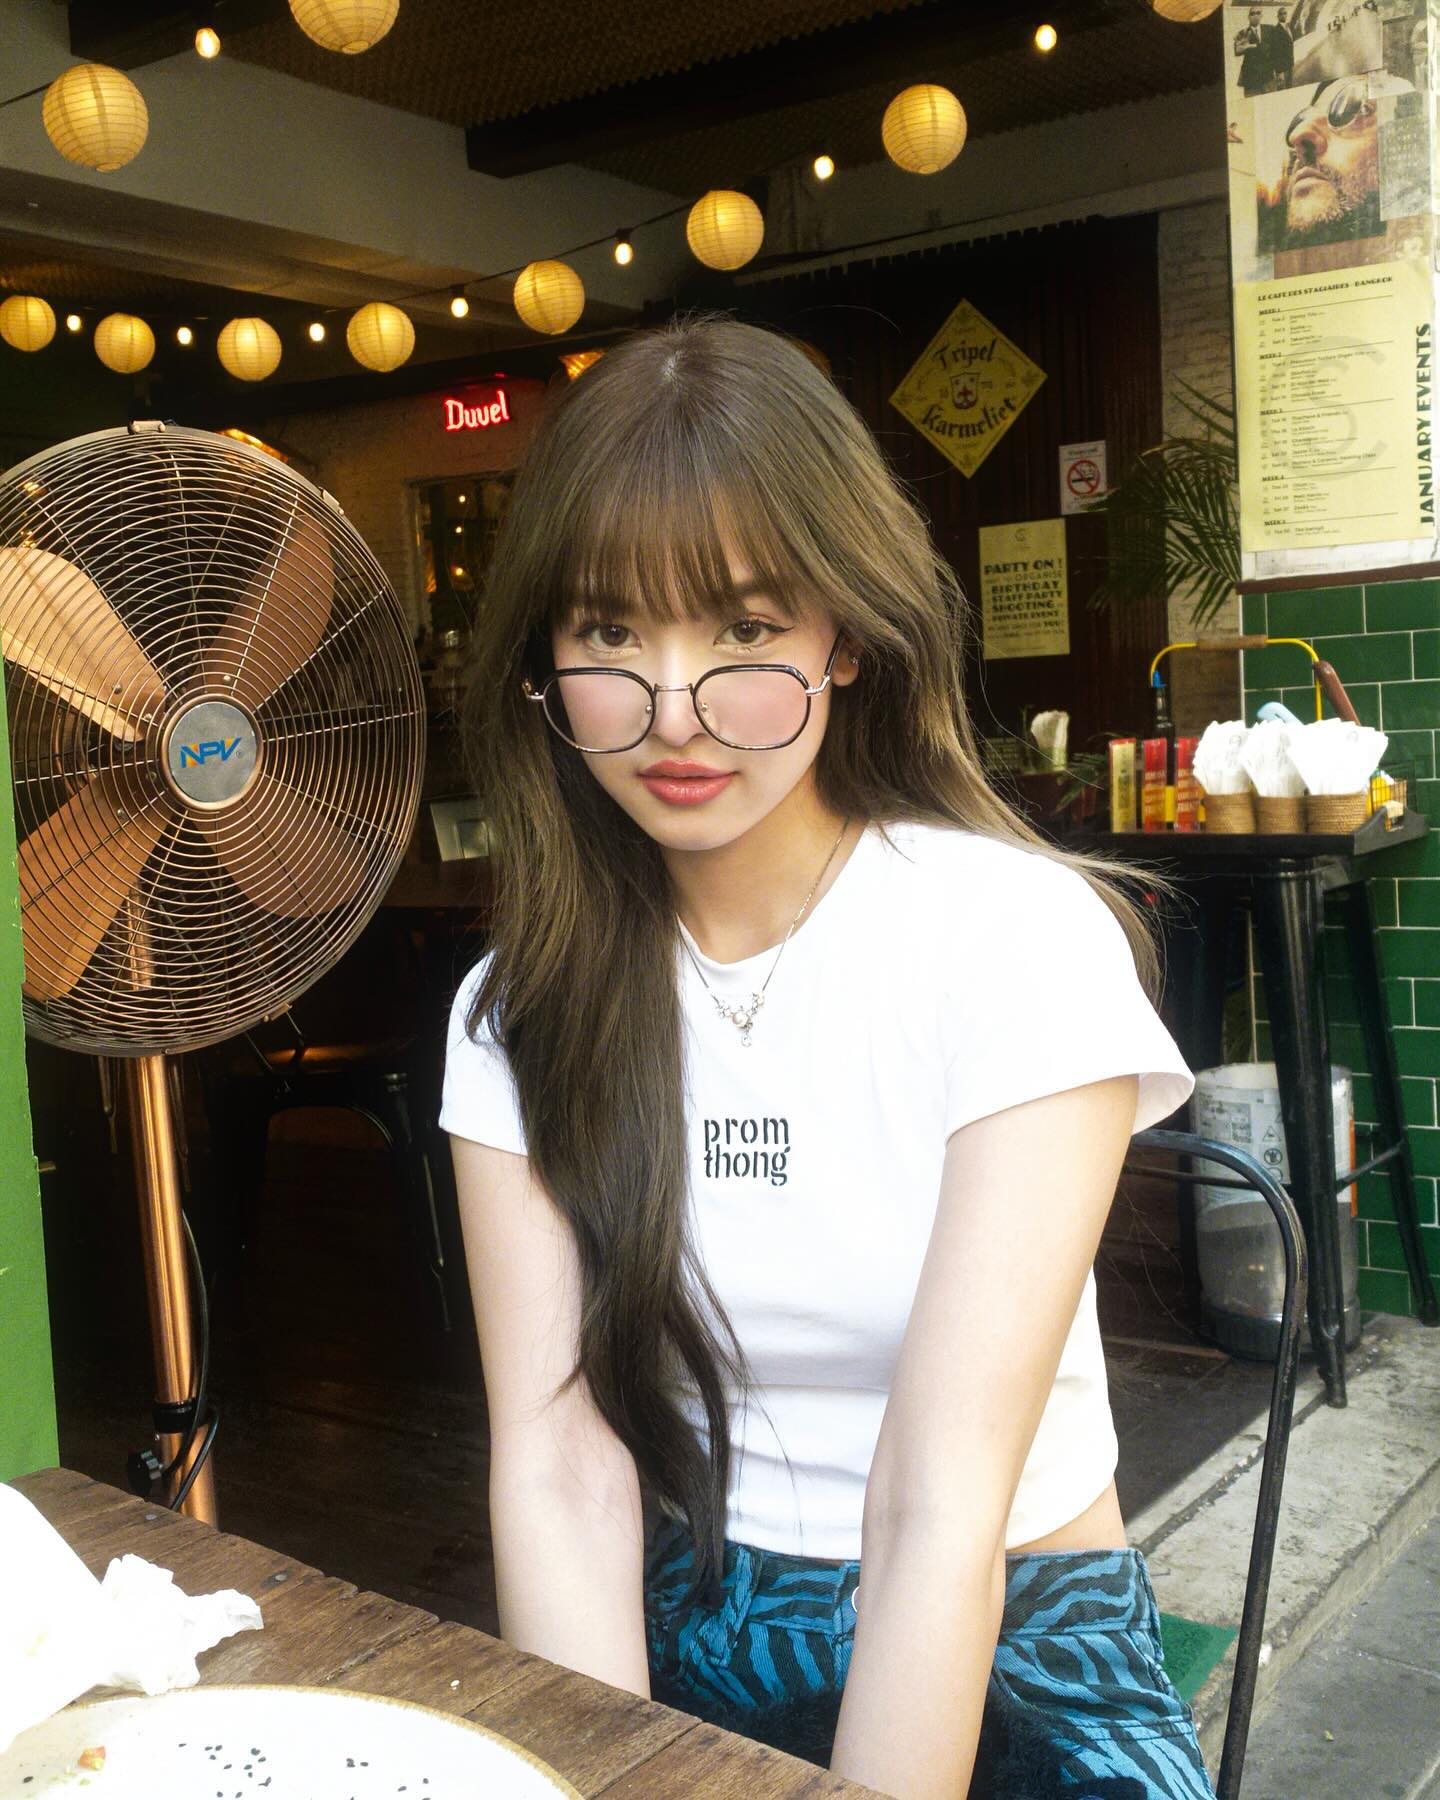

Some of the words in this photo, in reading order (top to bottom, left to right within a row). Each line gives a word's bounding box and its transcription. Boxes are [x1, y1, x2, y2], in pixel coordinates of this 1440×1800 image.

[1288, 289, 1302, 297] DES
[934, 338, 997, 369] Tripel
[1416, 323, 1431, 411] EVENTS
[444, 389, 510, 432] Duvel
[921, 398, 1016, 438] Karmeliet
[1416, 418, 1434, 526] JANUARY
[984, 562, 1028, 575] PARTY
[1033, 559, 1054, 570] ON
[1015, 571, 1063, 582] ORGANISE
[991, 580, 1060, 594] BIRTHDAY
[992, 594, 1024, 604] STAFF
[1026, 591, 1063, 602] PARTY
[992, 600, 1056, 613] SHOOTING
[992, 612, 1030, 623] PRIVATE
[1031, 610, 1060, 620] EVENT
[180, 737, 242, 769] NPV
[704, 1117, 789, 1151] prom
[704, 1143, 791, 1187] thong
